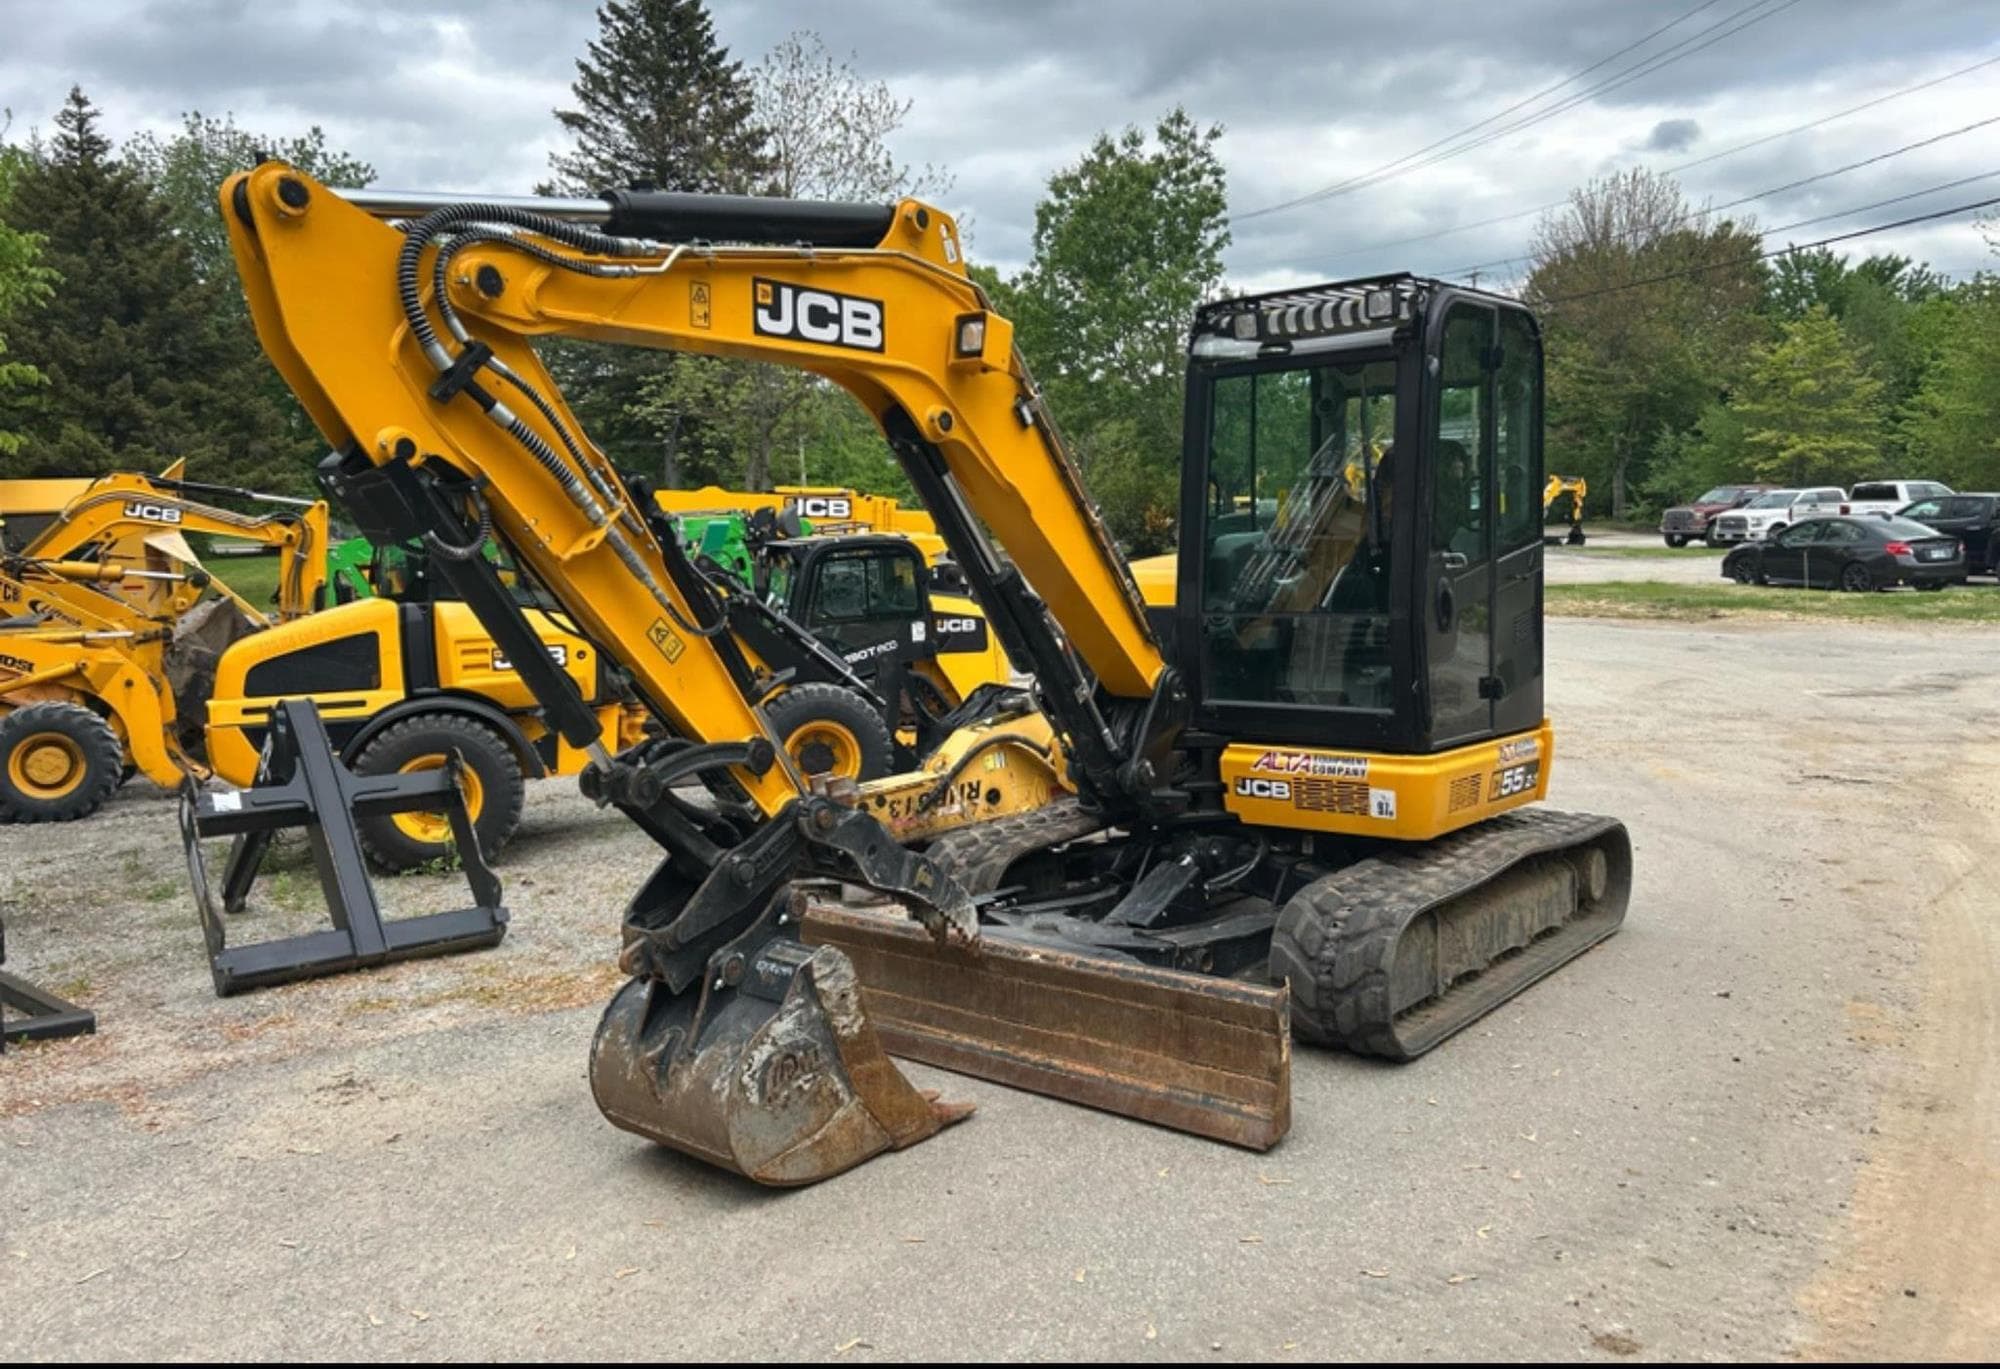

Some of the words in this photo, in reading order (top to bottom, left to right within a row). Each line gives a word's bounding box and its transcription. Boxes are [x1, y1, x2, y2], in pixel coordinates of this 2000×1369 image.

[757, 287, 882, 347] JCB
[125, 504, 181, 522] JCB
[936, 619, 976, 633] JCB
[1253, 752, 1311, 772] ALTA
[1312, 765, 1367, 777] COMPANY
[1236, 778, 1290, 799] JCB
